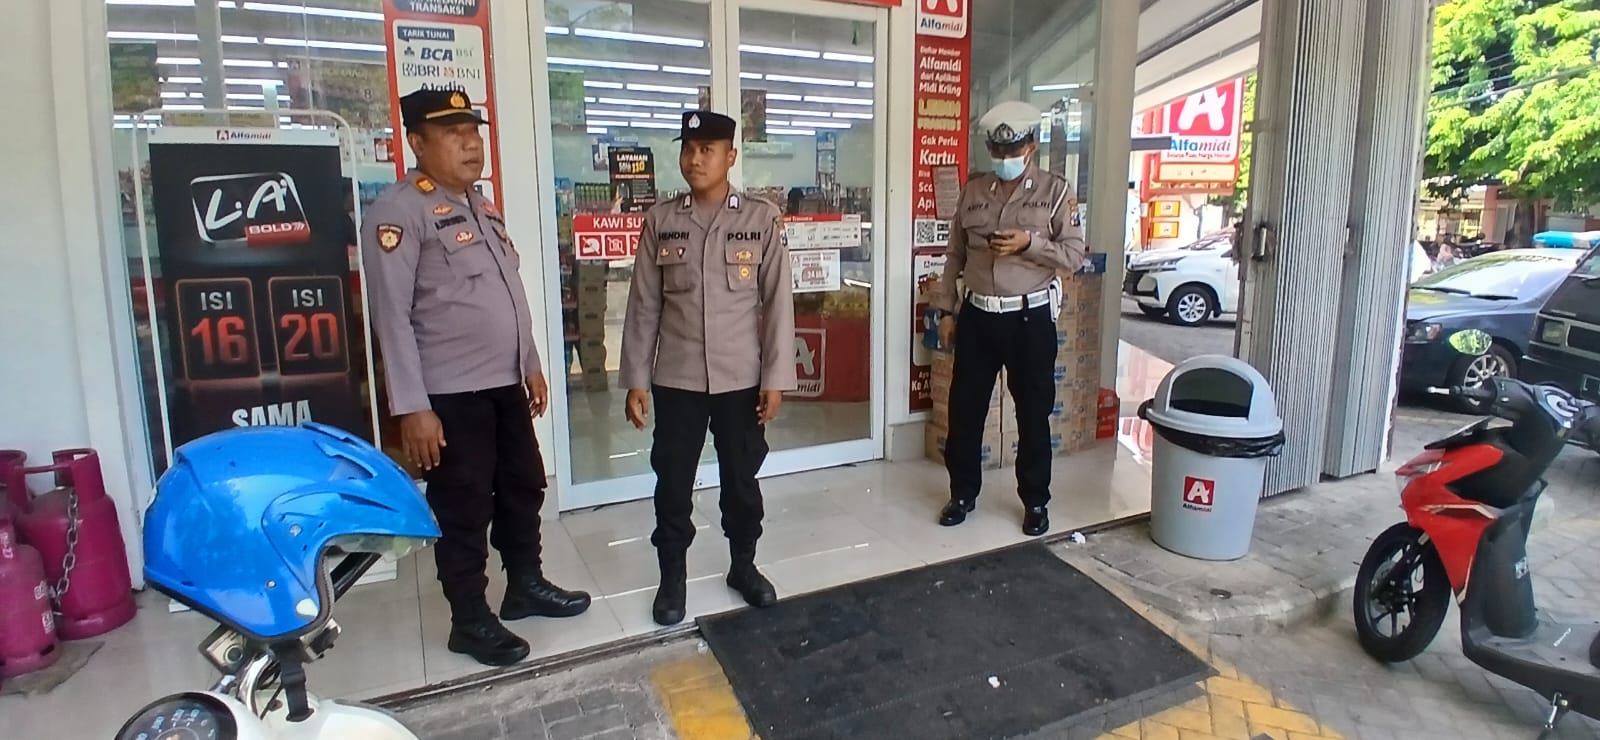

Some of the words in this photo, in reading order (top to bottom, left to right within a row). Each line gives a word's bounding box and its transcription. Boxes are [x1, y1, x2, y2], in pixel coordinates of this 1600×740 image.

[410, 2, 465, 16] TRANSAKSI
[920, 17, 963, 32] Alfamidi
[402, 28, 424, 38] TARIK
[426, 30, 450, 39] TUNAI
[420, 47, 453, 61] BCA
[919, 56, 961, 72] Alfamidi
[418, 64, 440, 77] BRI
[457, 68, 480, 79] BNI
[919, 82, 937, 93] Midi
[231, 131, 272, 140] Alfamidi
[921, 135, 936, 146] Gak
[938, 136, 958, 146] Perlu
[1171, 139, 1231, 151] Alfamidi
[249, 222, 292, 235] BOLD
[593, 217, 624, 229] KAWI
[658, 231, 689, 241] HENDRI
[727, 231, 761, 242] POLRI
[200, 291, 233, 311] ISI
[292, 288, 324, 308] ISI
[191, 316, 249, 365] 16
[281, 312, 340, 361] 20
[232, 399, 312, 427] SAMA
